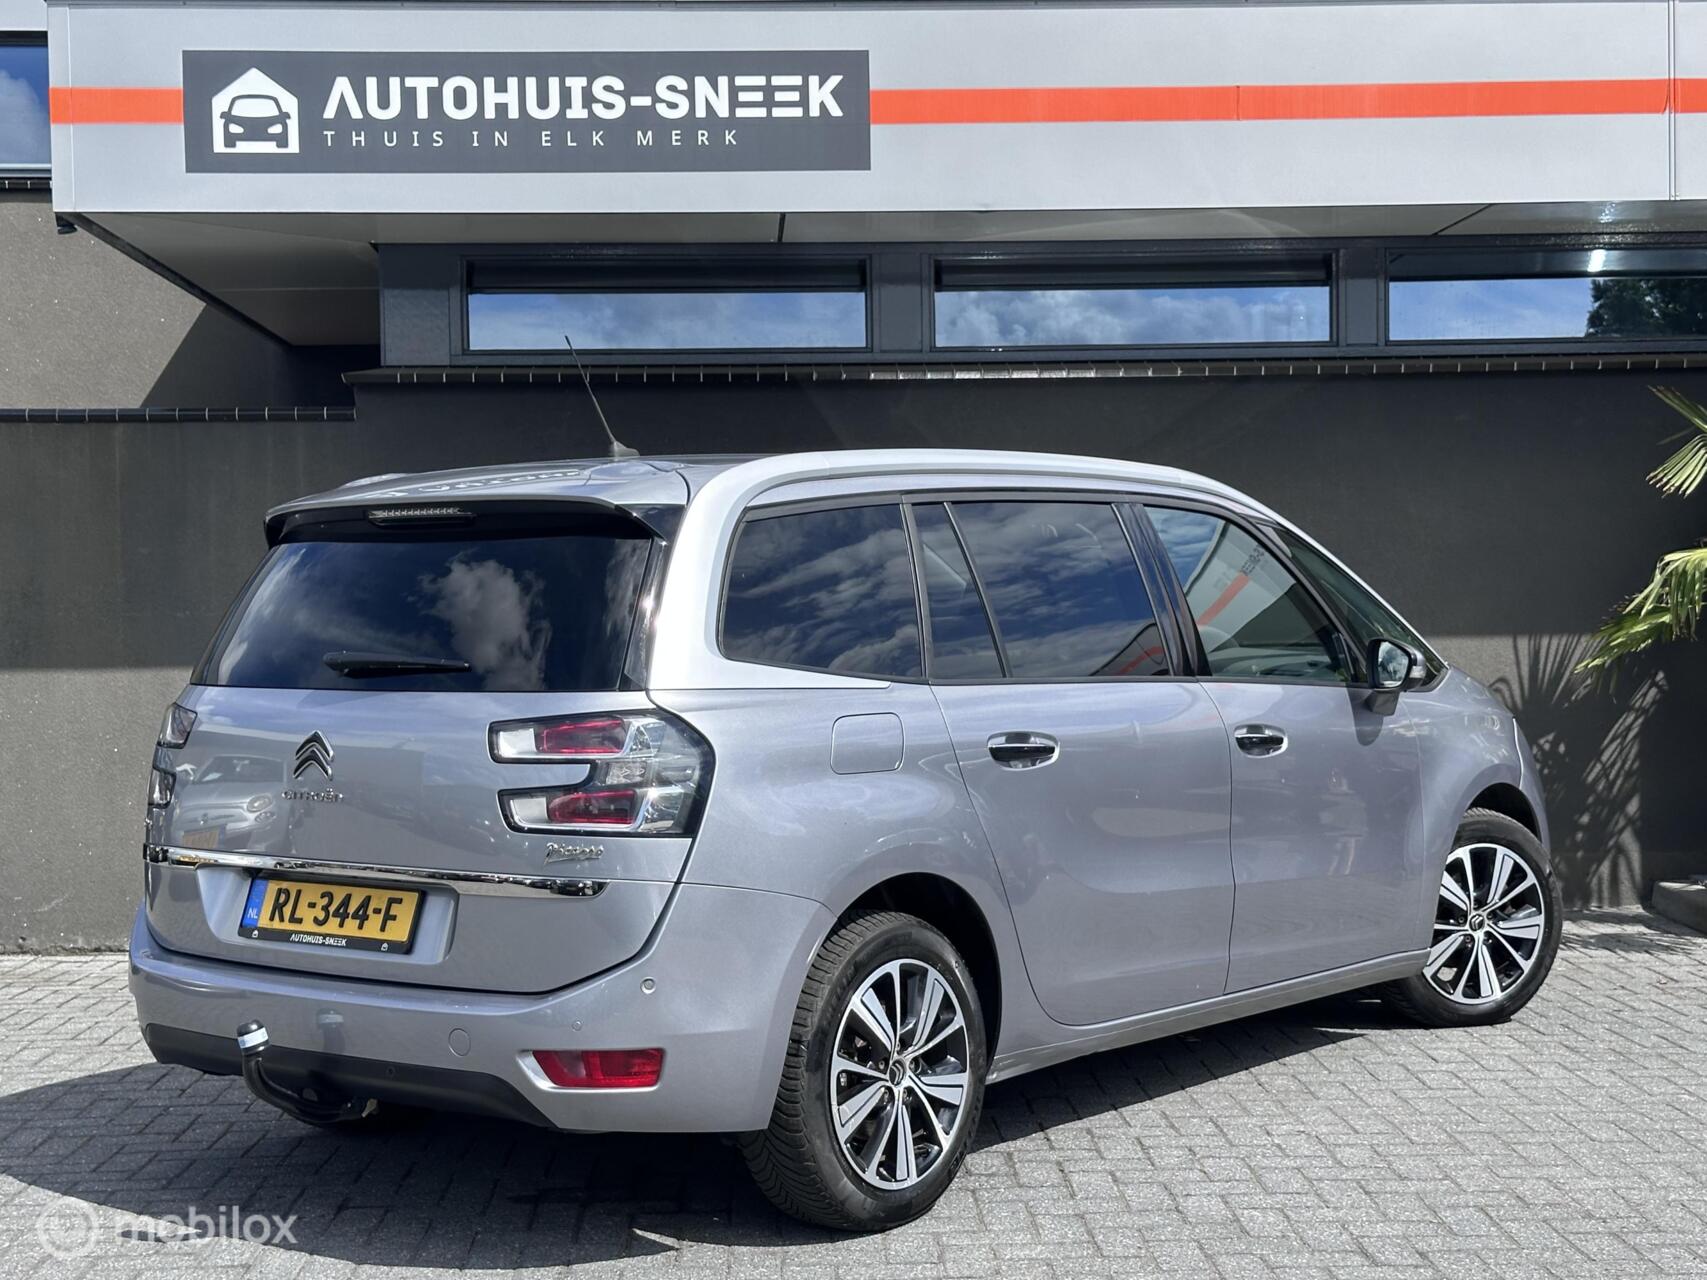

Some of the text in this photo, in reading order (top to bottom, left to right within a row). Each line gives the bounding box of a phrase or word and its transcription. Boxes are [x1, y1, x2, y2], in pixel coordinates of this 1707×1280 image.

[323, 74, 844, 121] AUTOHUIS-SNEEK
[324, 130, 739, 148] THUIS IN ELK MERK
[247, 907, 258, 920] NL
[268, 887, 403, 933] RL-344-F
[289, 933, 348, 947] AUTOHUIS-SNEEK
